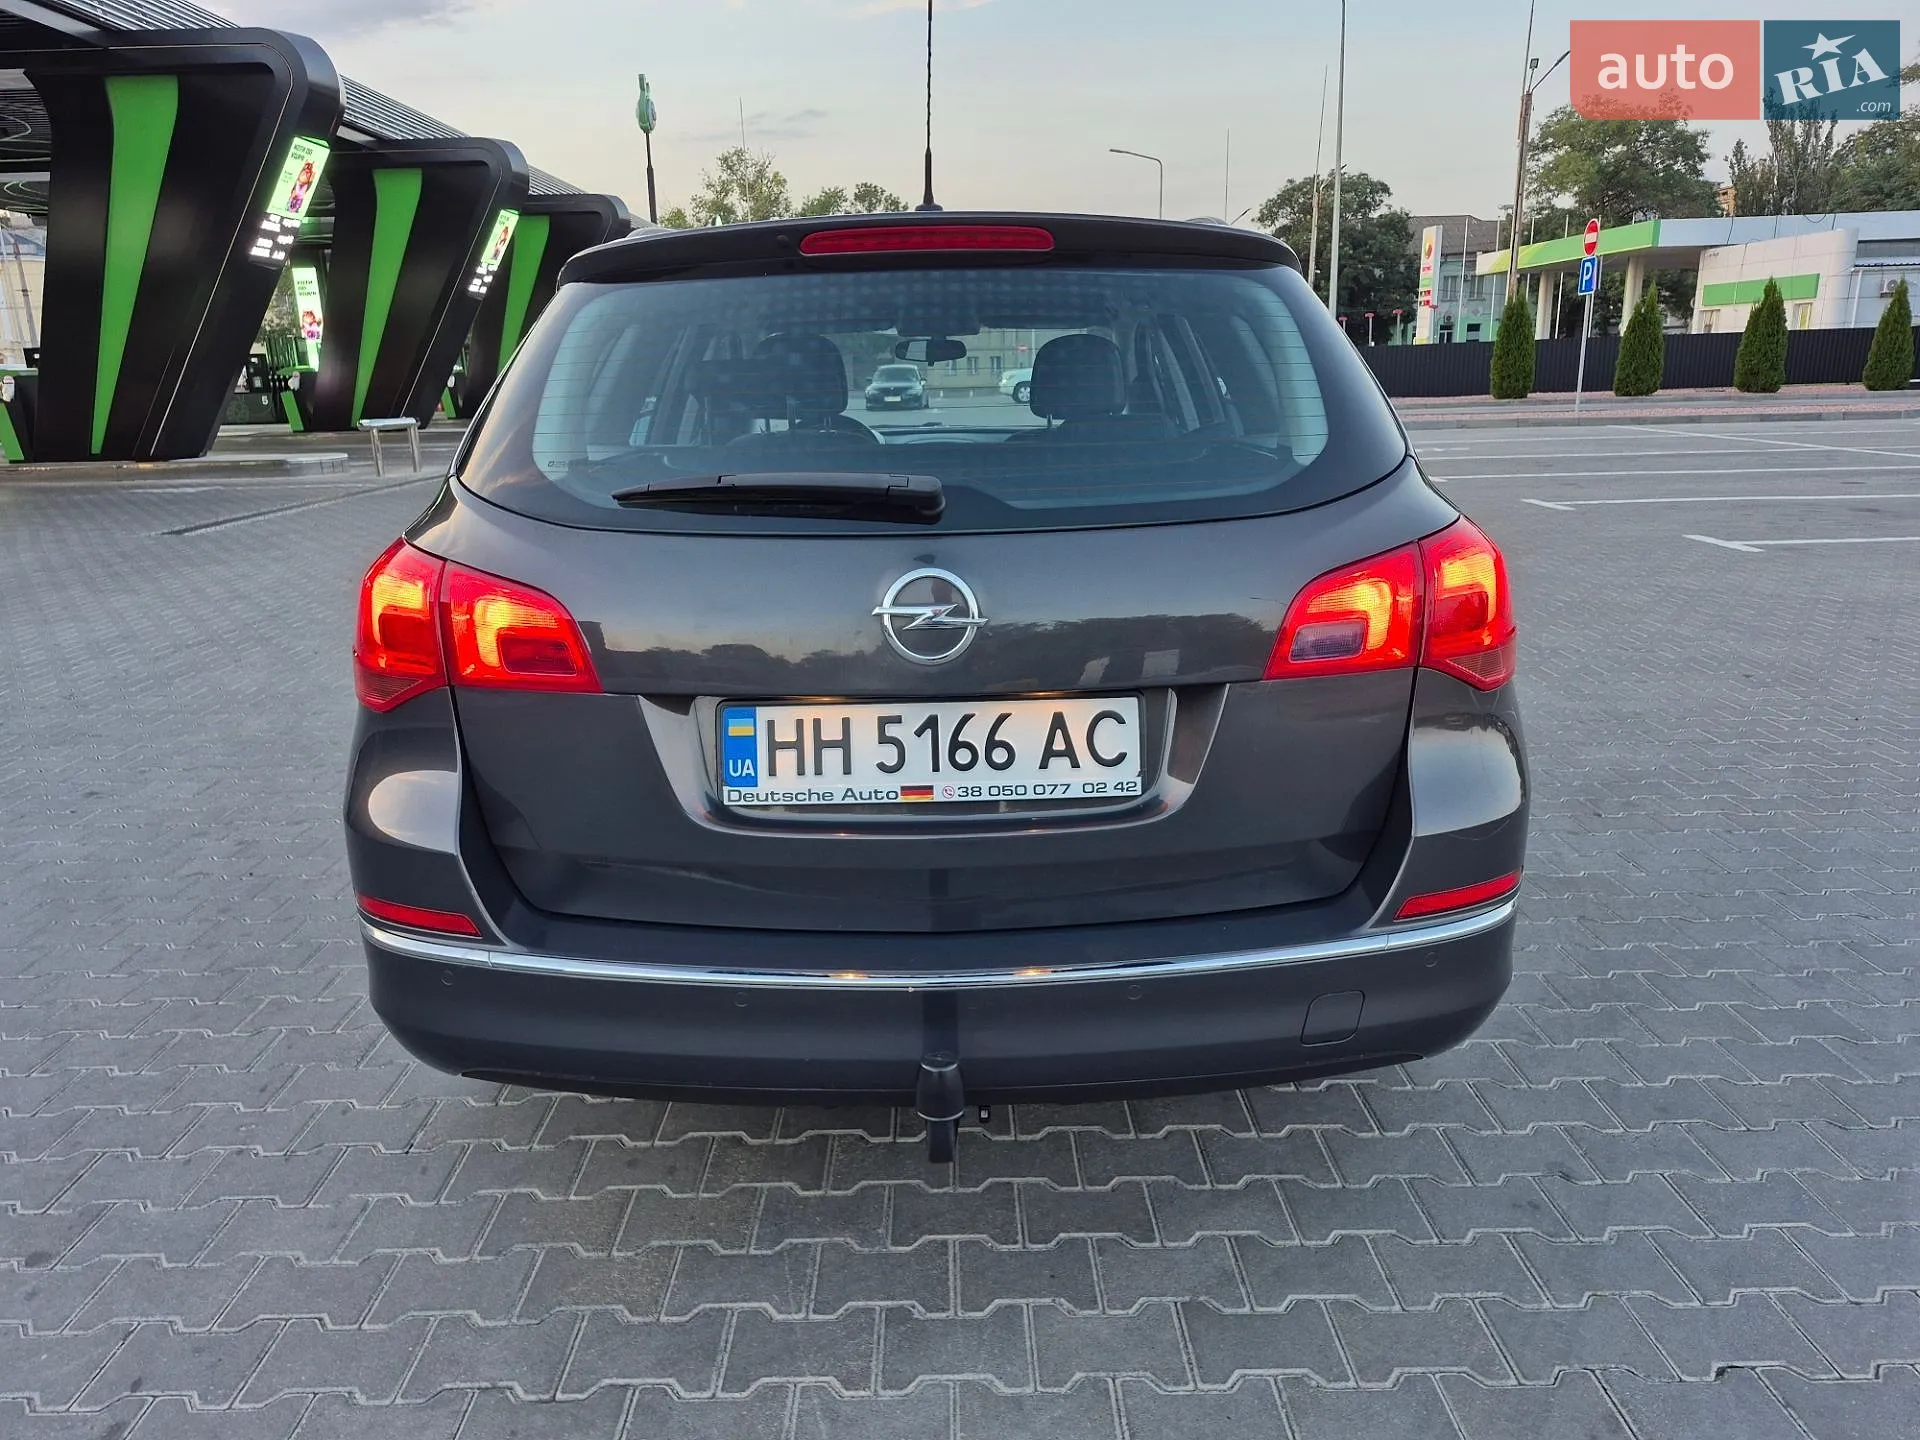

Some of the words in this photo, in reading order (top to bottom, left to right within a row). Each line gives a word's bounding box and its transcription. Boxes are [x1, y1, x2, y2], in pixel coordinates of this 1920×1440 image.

[1581, 261, 1593, 291] P
[767, 716, 852, 777] HH
[875, 712, 1016, 775] 5166
[1038, 709, 1128, 770] AC
[728, 759, 755, 777] UA
[727, 787, 834, 803] Deutsche
[841, 787, 899, 801] Auto
[957, 785, 982, 798] 38
[988, 784, 1028, 797] 050
[1033, 783, 1071, 796] 077
[1082, 782, 1108, 794] 02
[1113, 780, 1138, 793] 42
